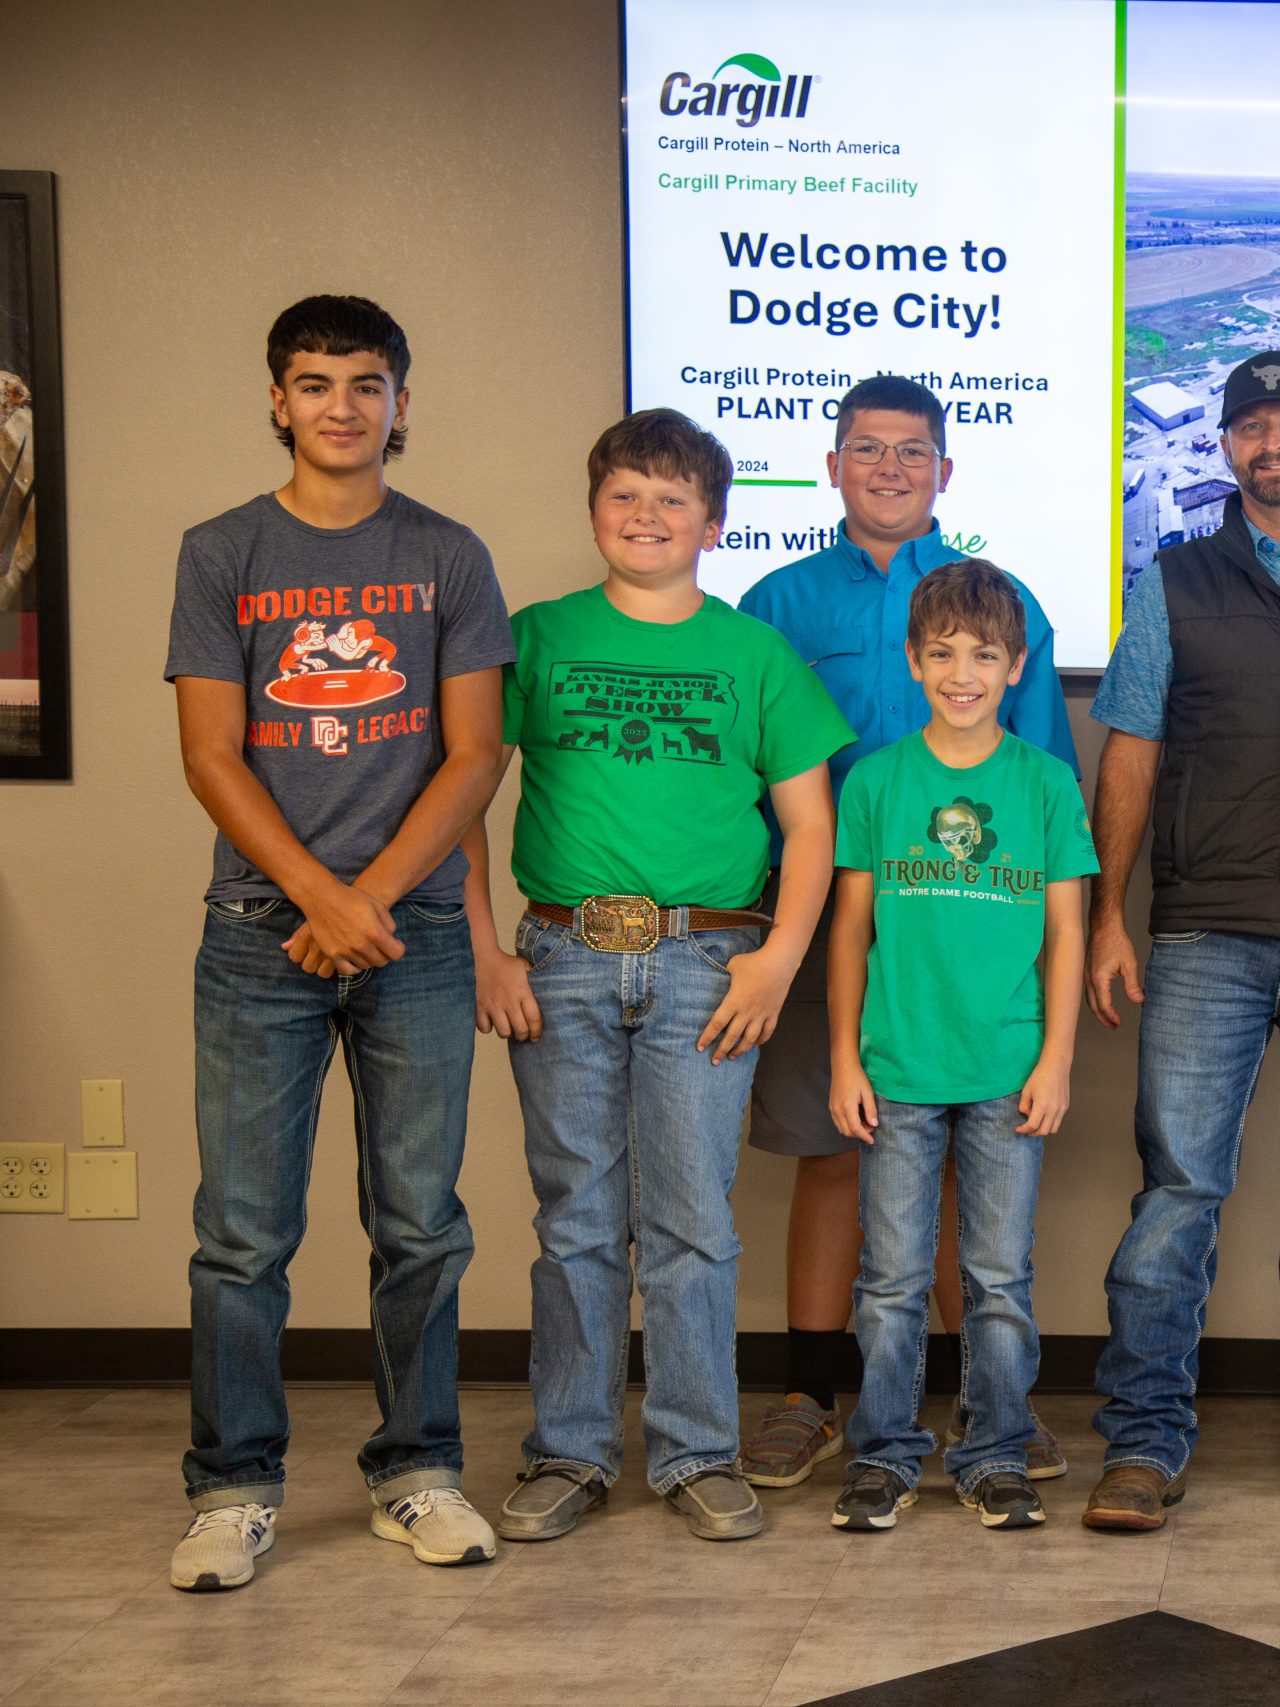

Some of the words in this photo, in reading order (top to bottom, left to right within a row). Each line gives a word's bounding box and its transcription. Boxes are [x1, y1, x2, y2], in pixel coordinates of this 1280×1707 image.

[660, 71, 812, 128] Cargill
[658, 135, 708, 153] Cargill
[714, 137, 769, 152] Protein
[788, 139, 831, 153] North
[836, 140, 900, 155] America
[658, 172, 719, 193] Cargill
[725, 174, 797, 195] Primary
[804, 176, 846, 193] Beef
[852, 177, 918, 198] Facility
[720, 231, 948, 272] Welcome
[960, 240, 1007, 274] to
[729, 289, 879, 337] Dodge
[893, 292, 1000, 339] City!
[680, 366, 760, 390] Cargill
[766, 368, 853, 390] Protein
[949, 372, 1049, 391] America
[717, 396, 814, 420] PLANT
[737, 460, 769, 472] 2024
[237, 586, 353, 625] DODGE
[361, 582, 436, 613] CITY
[552, 682, 728, 705] LIVESTOCK
[566, 673, 641, 686] KANSAS
[645, 680, 719, 690] JUNIOR
[585, 696, 691, 717] SHOW
[247, 720, 303, 747] AMILY
[908, 845, 924, 856] 20
[963, 863, 981, 884] &
[988, 865, 1045, 896] TRUE
[899, 887, 930, 897] NOTRE
[931, 888, 961, 897] DAME
[963, 890, 1014, 904] FOOTBALL
